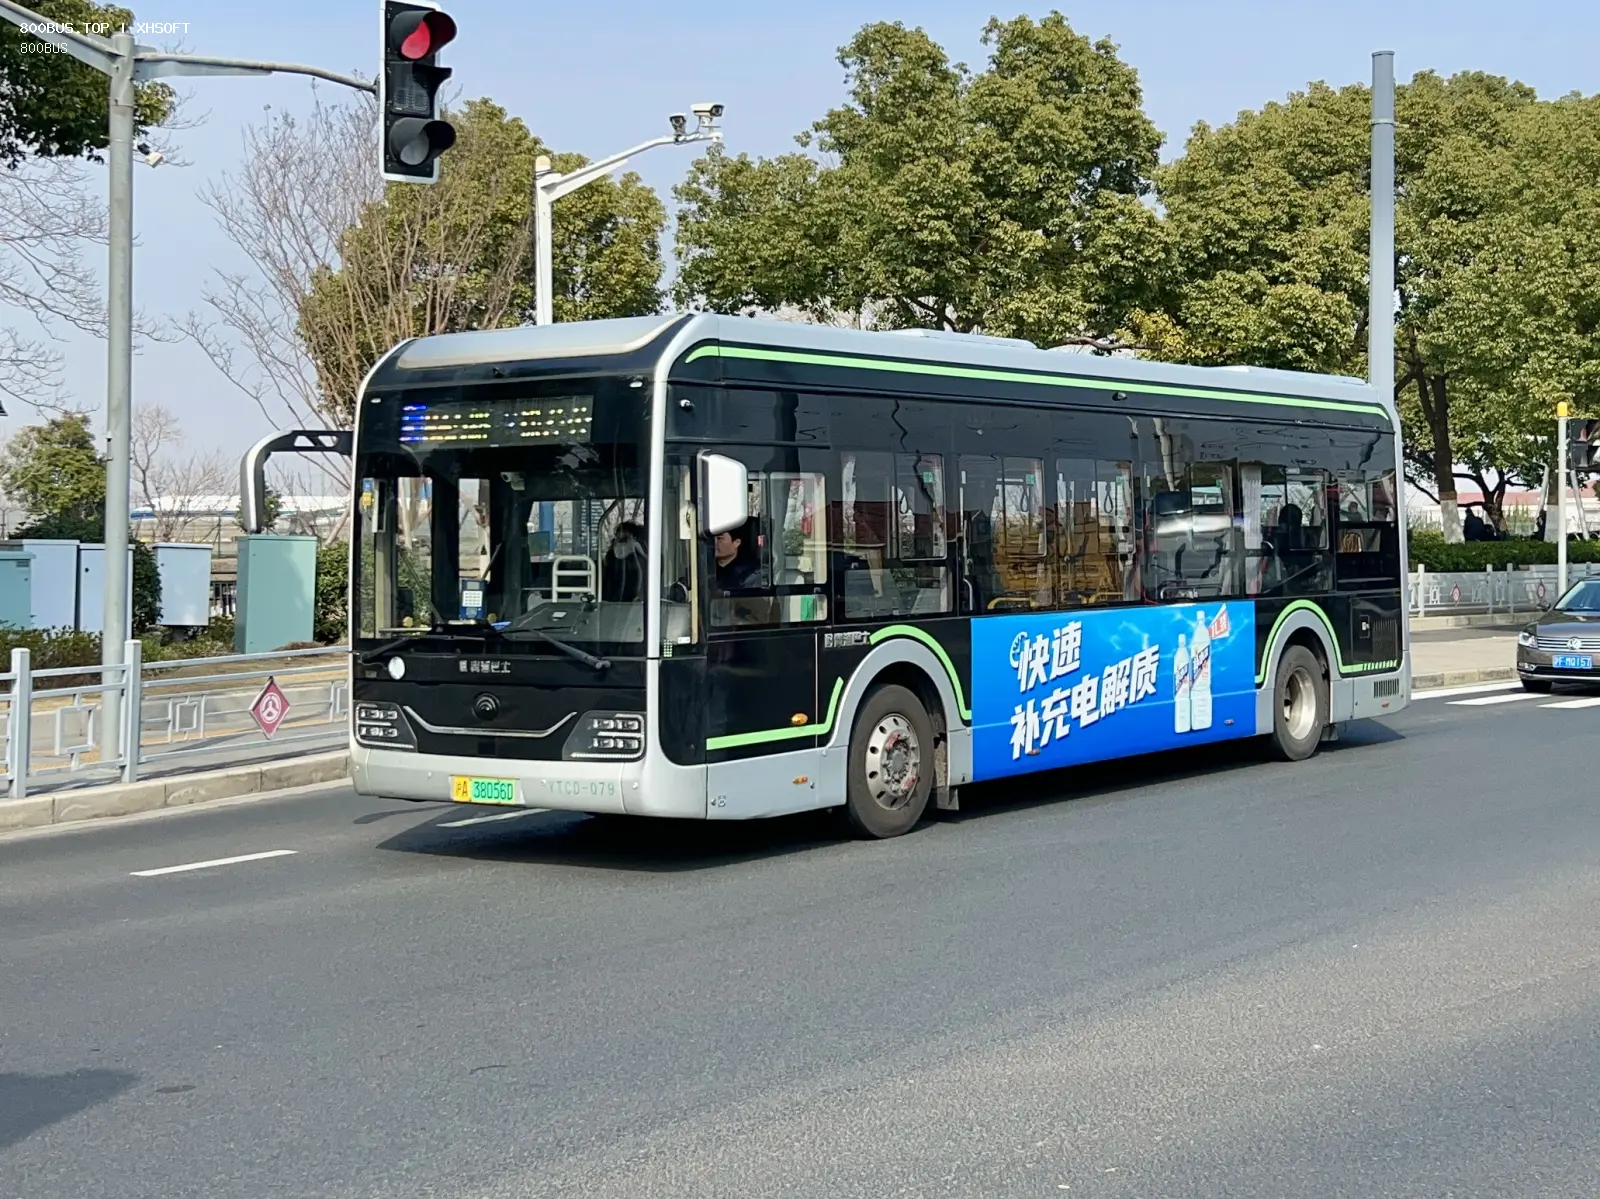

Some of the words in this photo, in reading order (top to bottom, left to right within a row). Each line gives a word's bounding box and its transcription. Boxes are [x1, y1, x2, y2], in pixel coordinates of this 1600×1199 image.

[1017, 620, 1082, 693] 快速
[1010, 644, 1160, 760] 补充电解质
[549, 780, 615, 796] YTCD-079
